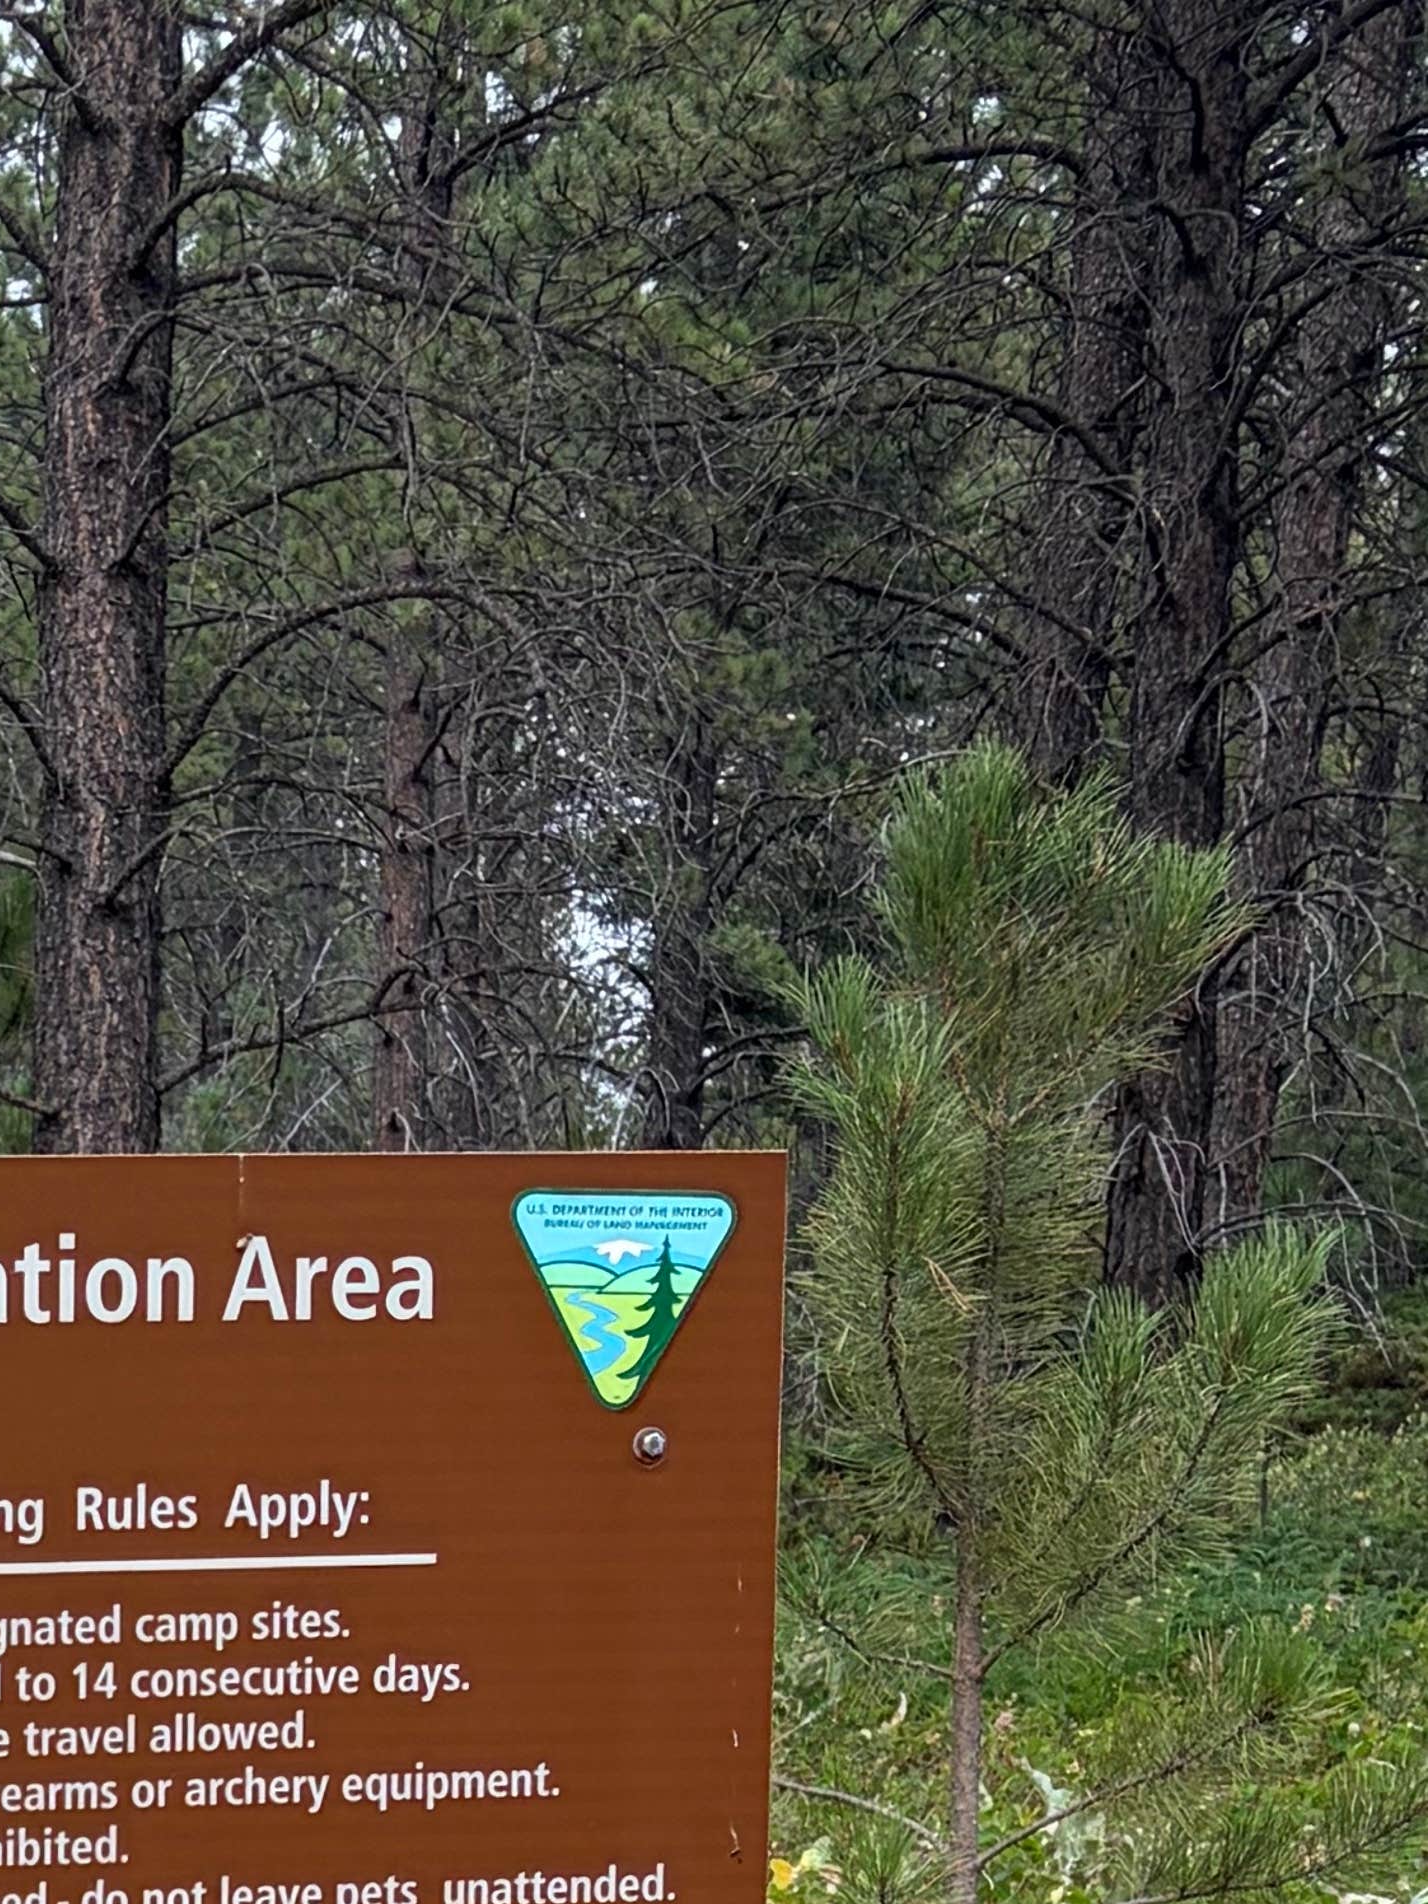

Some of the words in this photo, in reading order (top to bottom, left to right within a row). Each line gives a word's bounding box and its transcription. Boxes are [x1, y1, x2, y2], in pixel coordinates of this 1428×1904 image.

[552, 1204, 626, 1216] DEPARTMENT
[629, 1205, 644, 1217] OF
[649, 1206, 668, 1218] THE
[672, 1206, 724, 1218] INTERIOR
[586, 1219, 601, 1229] OF
[603, 1219, 633, 1230] LAND
[222, 1235, 434, 1321] Area
[76, 1482, 198, 1531] Rules
[224, 1479, 369, 1539] Apply:
[135, 1611, 238, 1651] camp
[252, 1600, 350, 1640] sites.
[15, 1666, 56, 1702] to
[72, 1661, 118, 1700] 14
[130, 1655, 360, 1699] consecutive
[373, 1653, 470, 1703] days.
[23, 1714, 136, 1757] travel
[149, 1709, 315, 1753] allowed.
[131, 1779, 173, 1808] or
[184, 1765, 330, 1814] archery
[342, 1761, 560, 1812] equipment.
